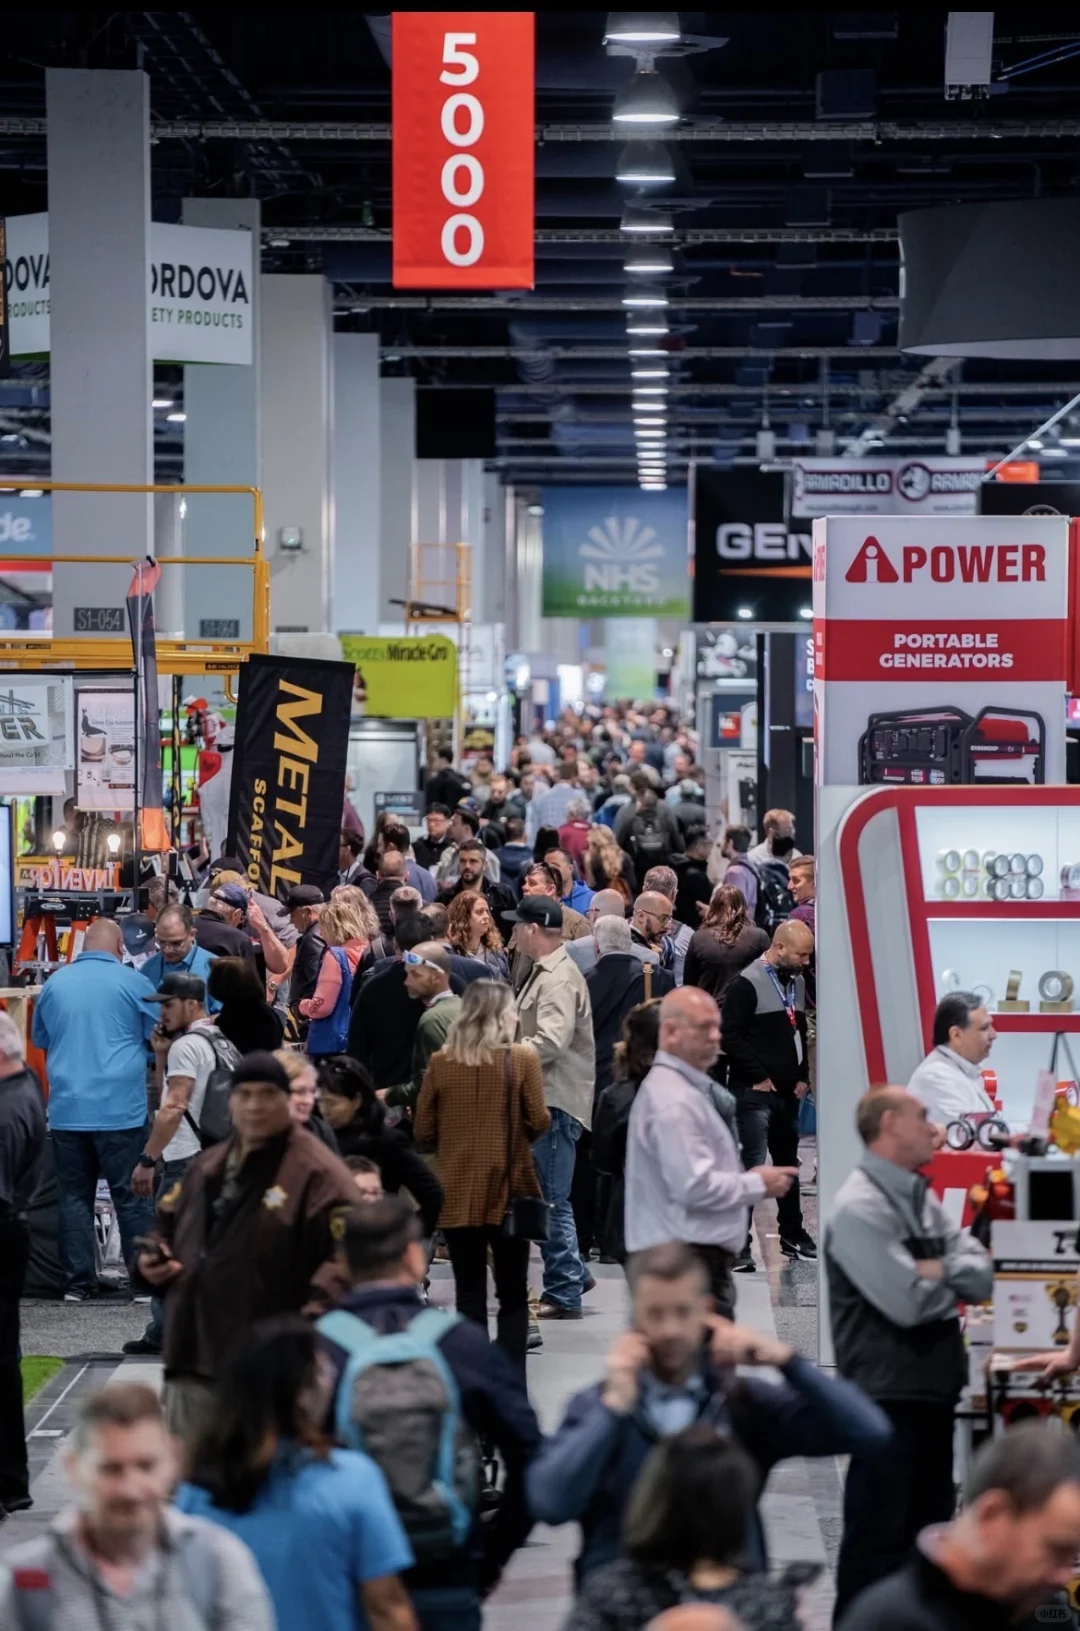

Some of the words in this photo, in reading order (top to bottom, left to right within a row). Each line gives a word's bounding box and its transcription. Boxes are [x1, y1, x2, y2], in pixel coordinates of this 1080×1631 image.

[440, 33, 484, 266] 5000
[177, 309, 243, 329] PRODUCTS
[583, 563, 660, 593] NHS
[77, 609, 120, 630] S1-054
[894, 633, 998, 648] PORTABLE
[879, 653, 1014, 668] GENERATORS
